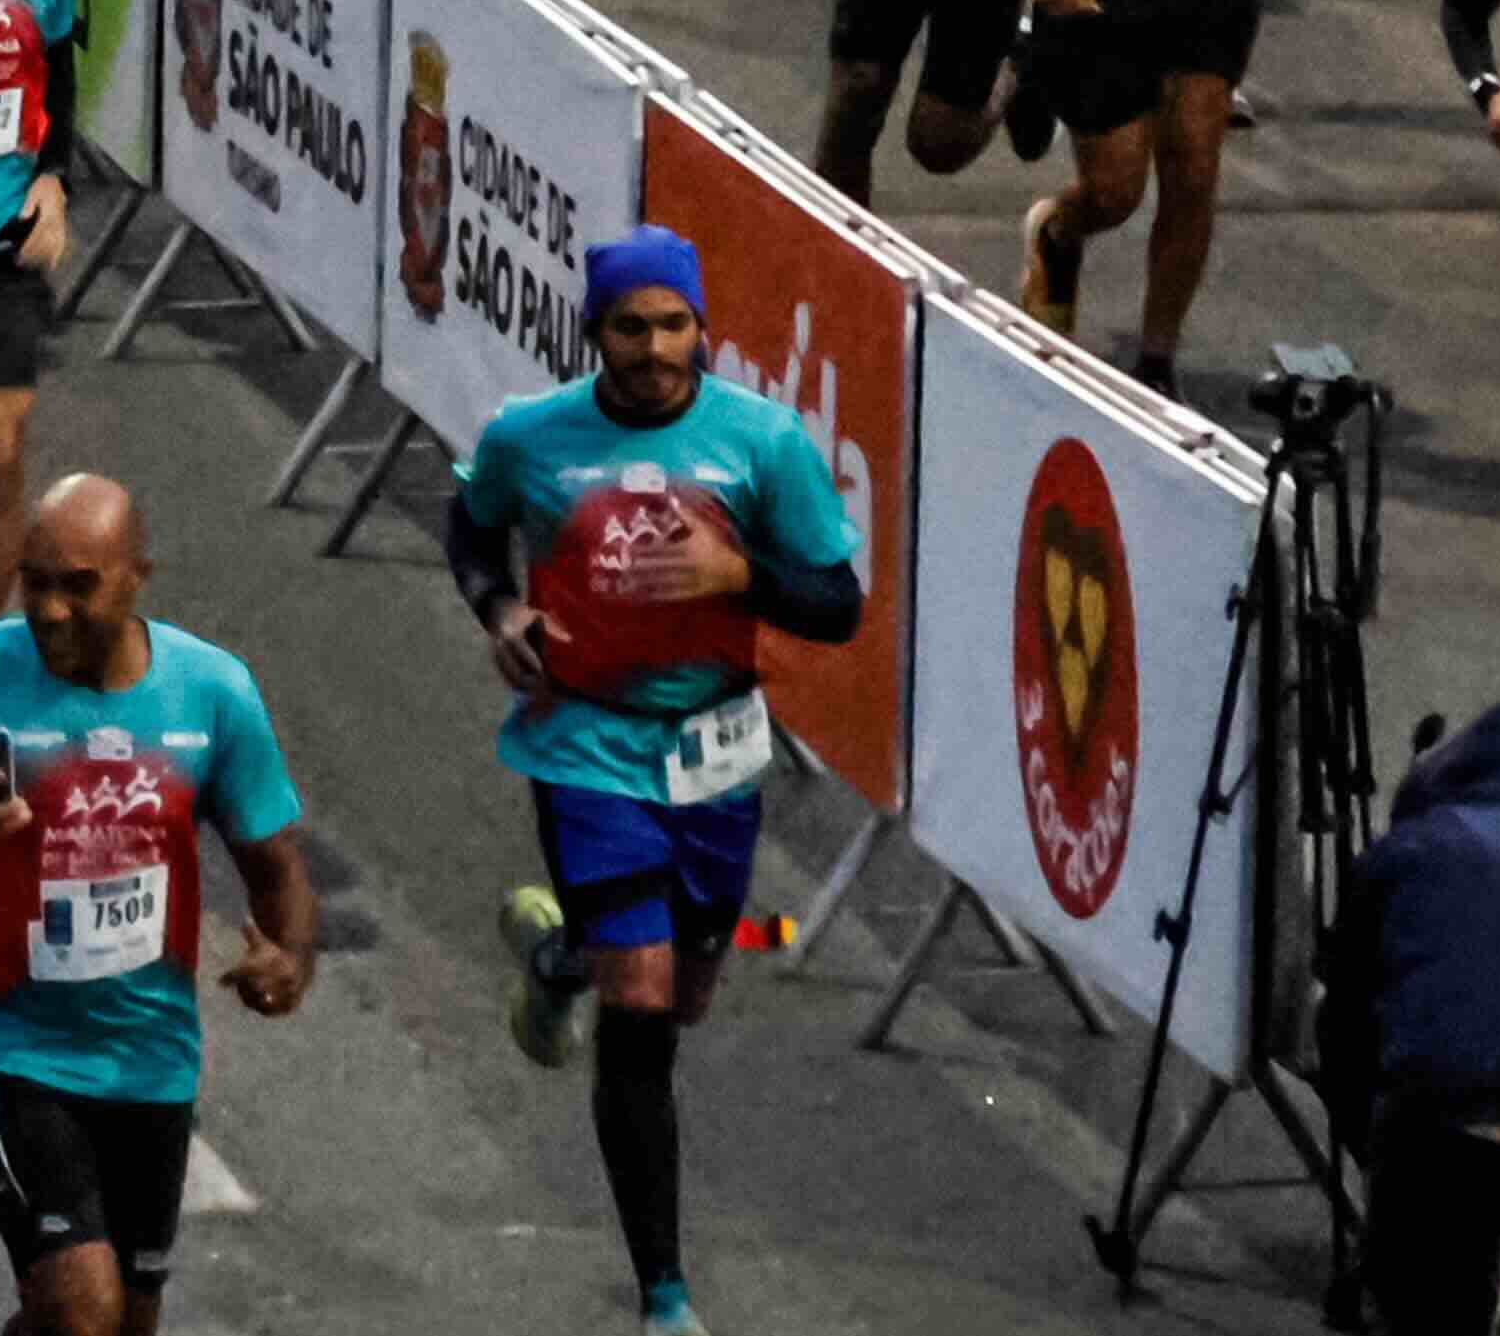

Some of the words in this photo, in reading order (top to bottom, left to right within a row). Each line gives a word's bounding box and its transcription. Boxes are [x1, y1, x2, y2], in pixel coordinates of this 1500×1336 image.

[228, 22, 281, 135] SÃO
[285, 82, 367, 205] PAULO
[458, 114, 541, 240] CIDADE
[545, 178, 577, 271] DE
